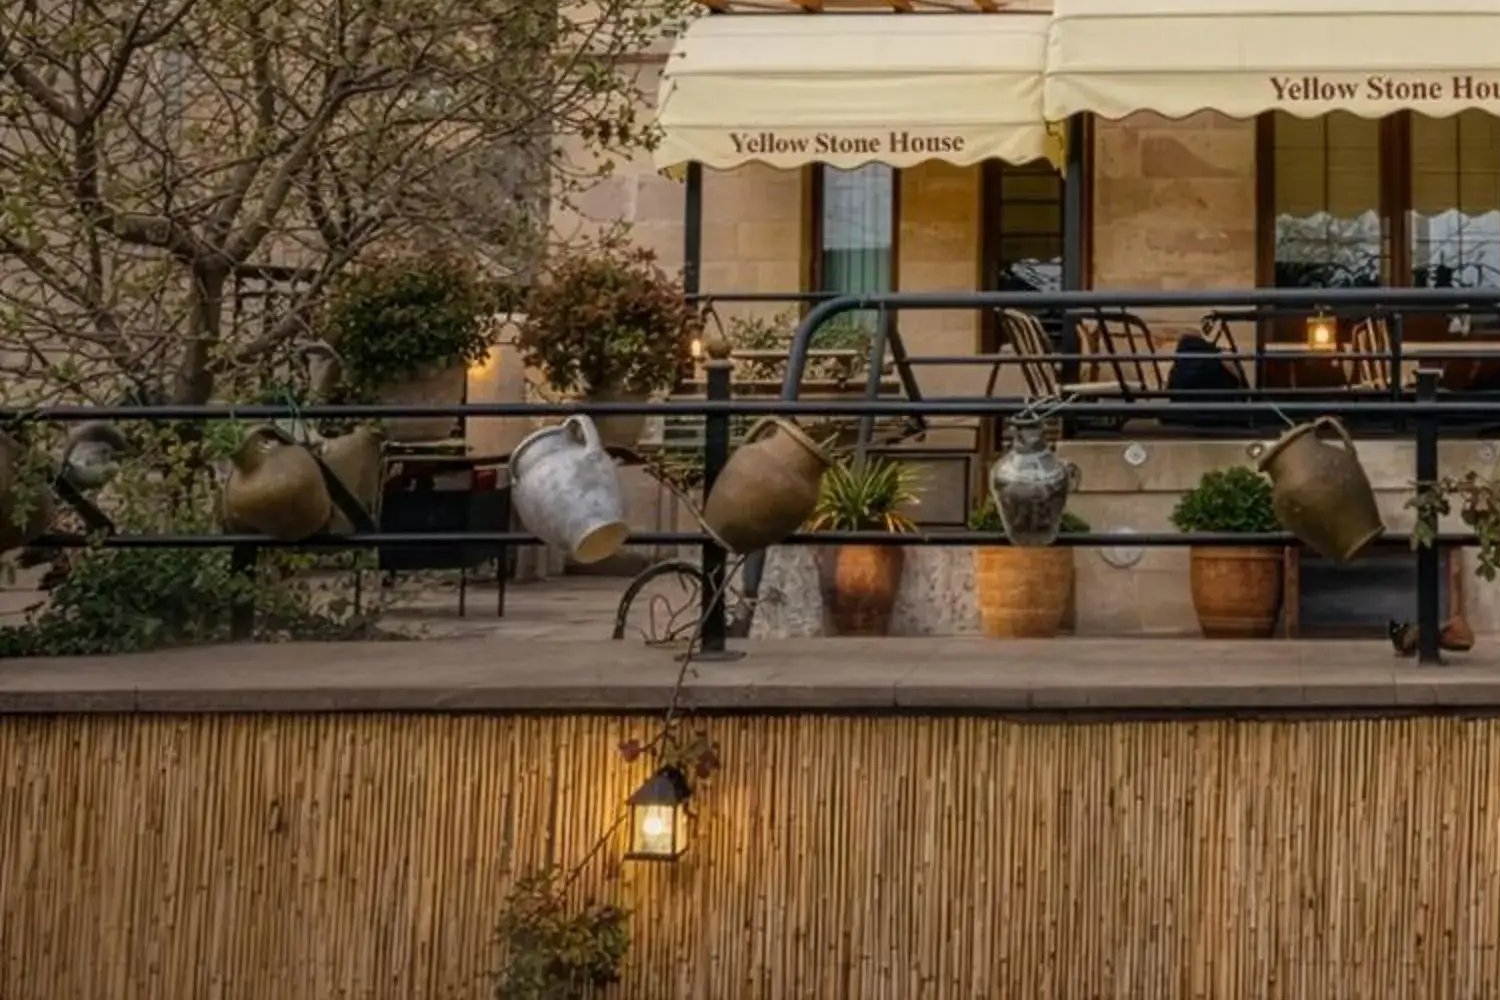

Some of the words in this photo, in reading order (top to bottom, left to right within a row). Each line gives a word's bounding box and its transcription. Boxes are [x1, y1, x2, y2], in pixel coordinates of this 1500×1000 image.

[1269, 76, 1358, 101] Yellow
[1366, 76, 1443, 100] Stone
[729, 132, 809, 154] Yellow
[814, 132, 881, 153] Stone
[889, 131, 965, 152] House
